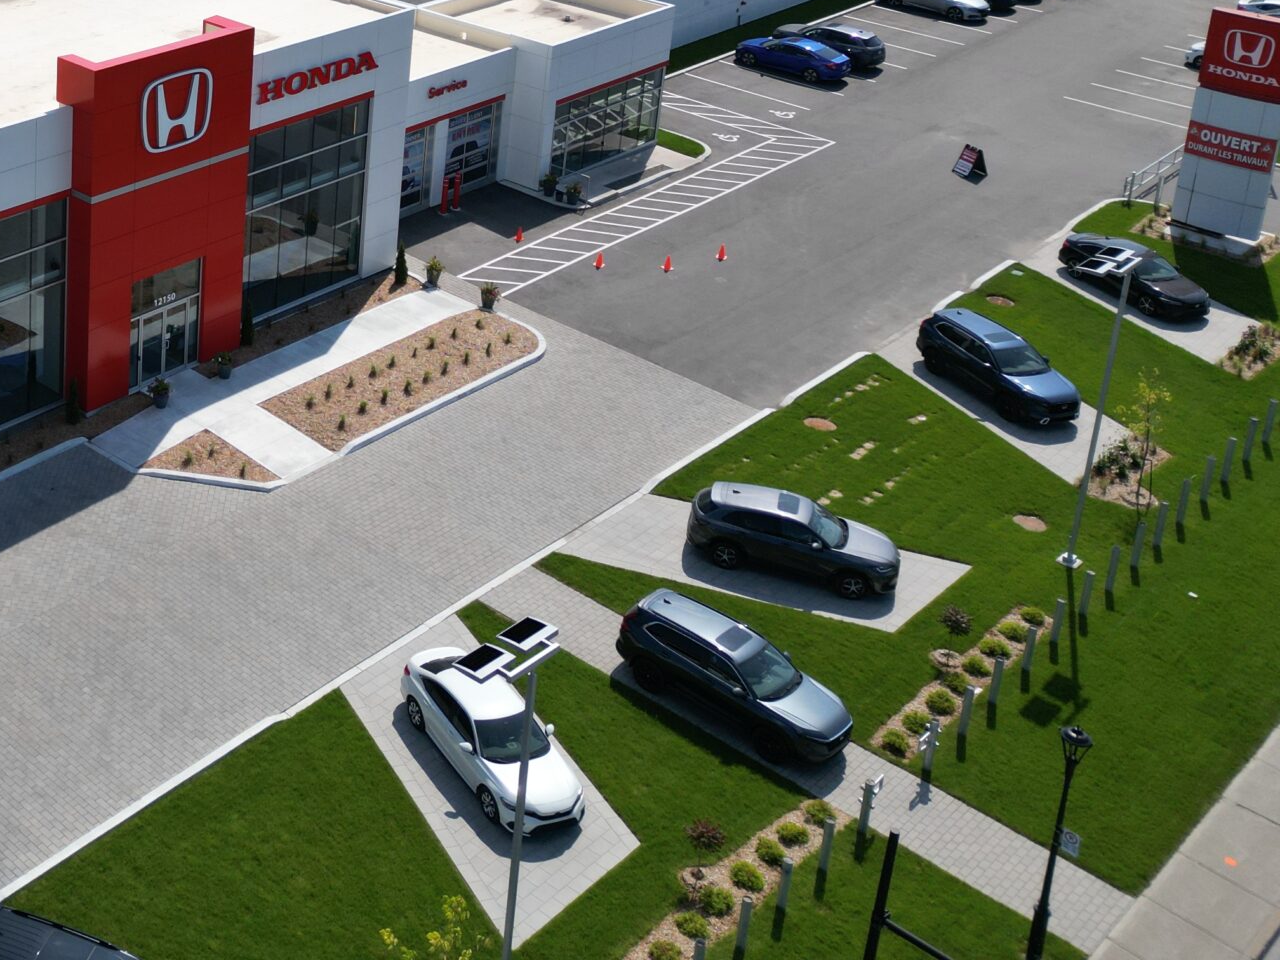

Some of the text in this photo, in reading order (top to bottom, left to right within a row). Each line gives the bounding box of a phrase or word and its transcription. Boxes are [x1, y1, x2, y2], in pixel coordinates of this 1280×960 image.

[256, 51, 379, 105] HONDA
[1208, 63, 1280, 87] HONDA
[428, 80, 468, 99] Service
[1200, 129, 1262, 153] OUVERT
[1188, 141, 1269, 167] DURANT LES TRAVAUX
[154, 292, 176, 307] 12150
